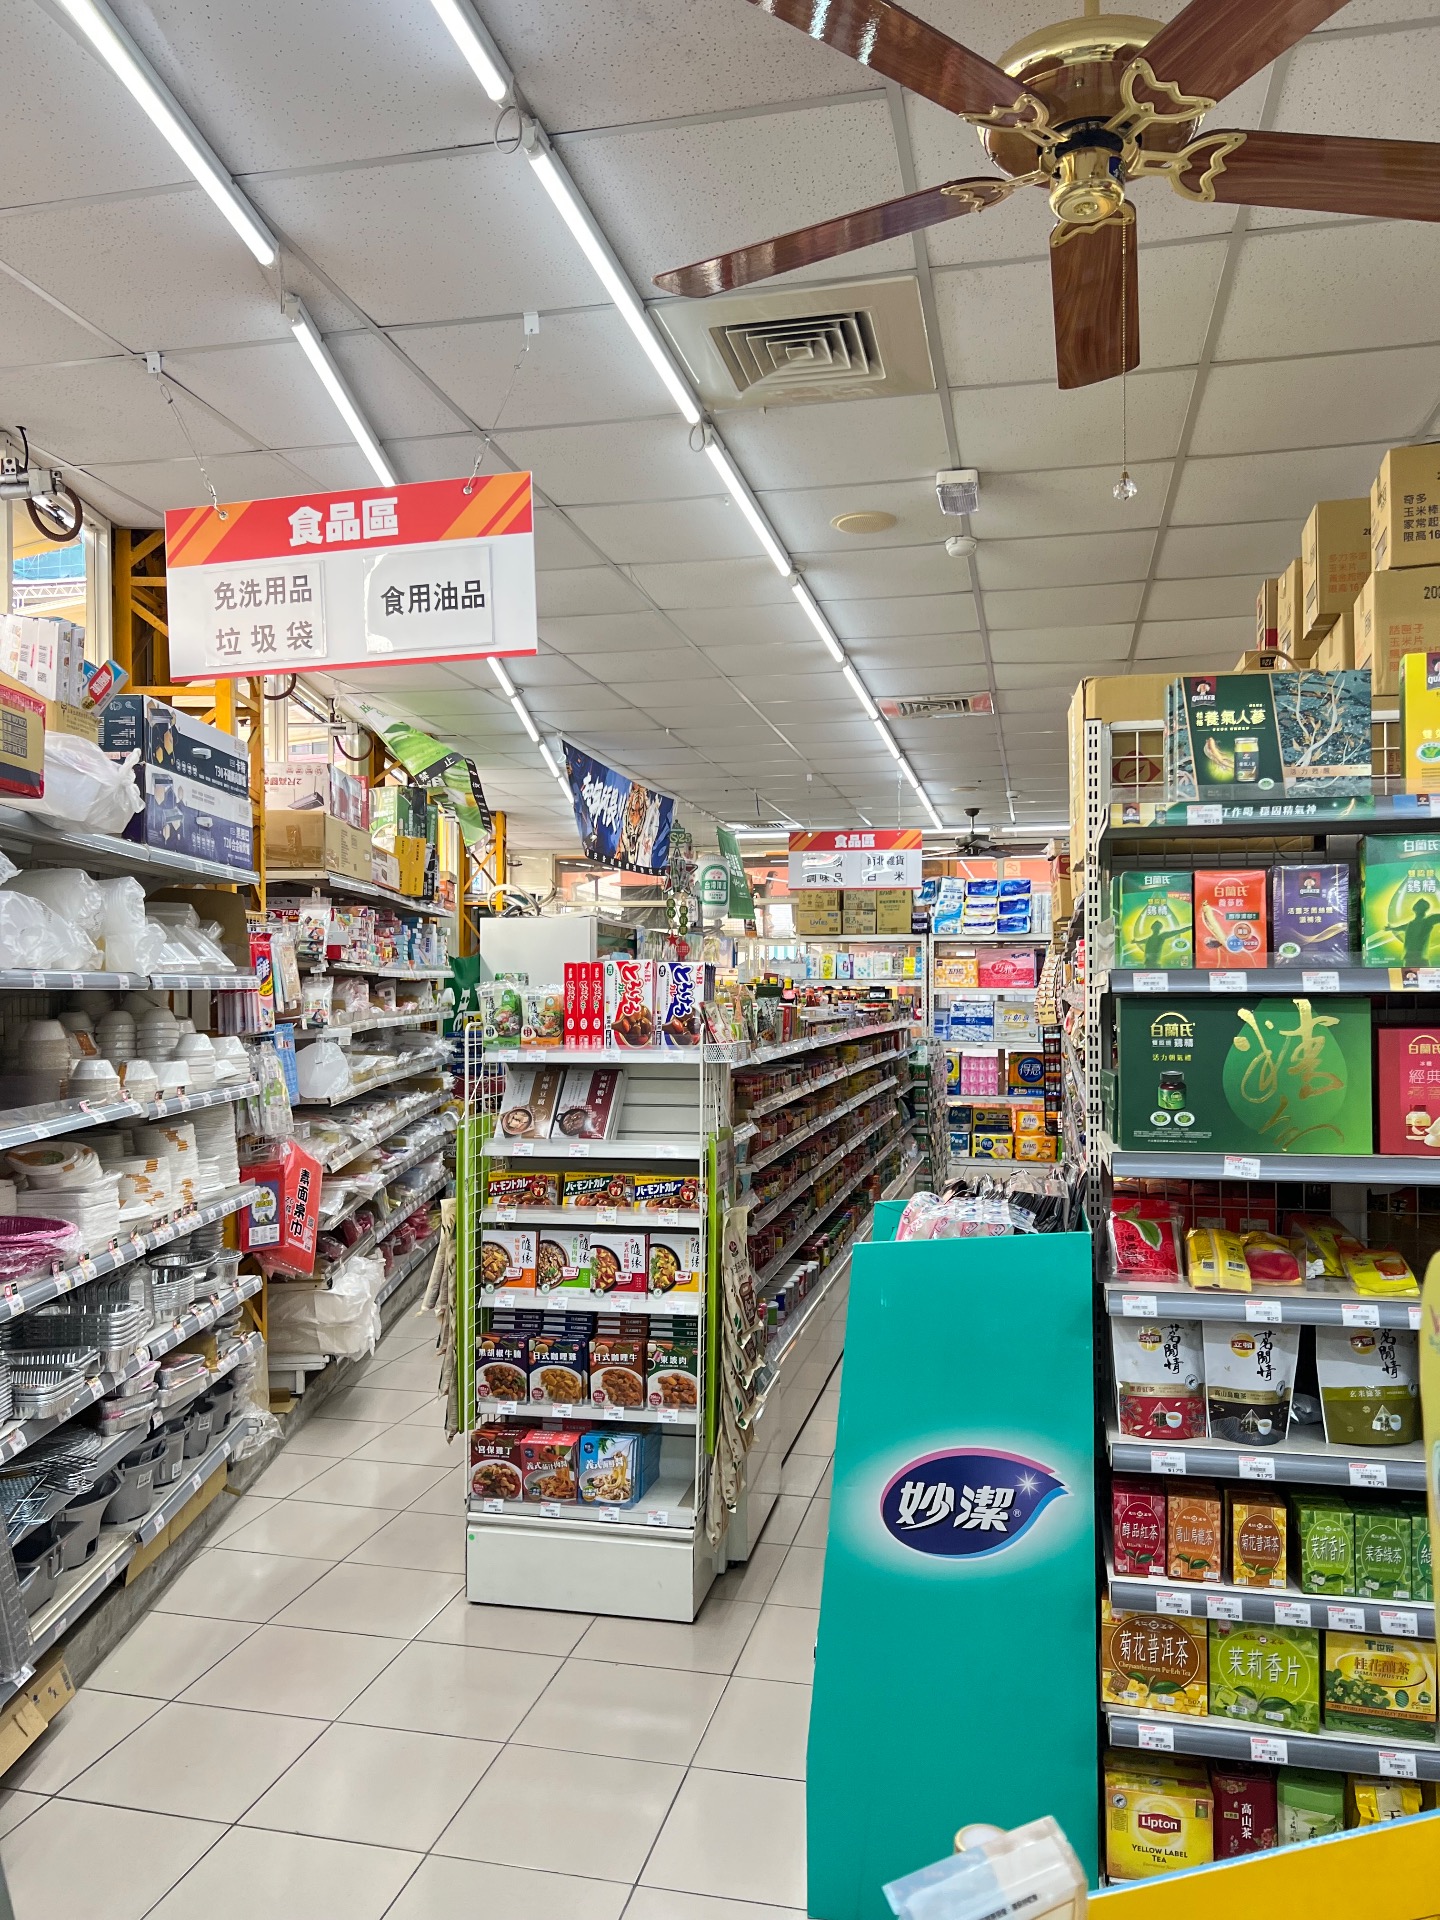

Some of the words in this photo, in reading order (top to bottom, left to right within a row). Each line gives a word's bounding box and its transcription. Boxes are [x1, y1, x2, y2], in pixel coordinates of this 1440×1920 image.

[1403, 494, 1427, 504] 奇多
[288, 496, 399, 547] 食品區
[214, 574, 313, 611] 免洗用品
[380, 580, 486, 617] 食用油品
[215, 620, 314, 656] 垃圾袋
[1389, 636, 1424, 647] 玉米片
[1191, 694, 1216, 702] QUAKER
[1203, 709, 1266, 727] 養氣人蔘
[1259, 804, 1317, 817] 穩固精氣神
[834, 833, 876, 848] 食品區
[1403, 840, 1439, 852] 白蘭氏
[1144, 875, 1171, 885] 白蘭氏
[1214, 886, 1248, 898] 白蘭氏
[621, 963, 644, 1016] とろける
[673, 965, 696, 1018] とろける
[1150, 1023, 1195, 1038] 白蘭氏
[1408, 1043, 1440, 1055] 白蘭氏
[1408, 1069, 1440, 1084] 經典
[489, 1178, 533, 1192] バーモントカレー
[565, 1178, 610, 1192] バーモントカレー
[635, 1182, 682, 1196] バーモントカレー
[1232, 1341, 1254, 1351] 立頓
[896, 1481, 1017, 1532] 妙潔
[1121, 1521, 1159, 1541] 醇品紅茶
[1175, 1525, 1213, 1546] 高山烏龍茶
[1240, 1533, 1280, 1554] 菊花普洱茶
[1310, 1535, 1347, 1561] 茉莉香片
[1365, 1545, 1402, 1565] 茉香綠茶
[1119, 1629, 1189, 1668] 菊花普洱茶
[1118, 1660, 1161, 1674] Chrysanthemum
[1181, 1668, 1191, 1677] Tea
[1226, 1645, 1301, 1688] 茉莉香片
[1353, 1656, 1410, 1676] 桂花釀茶
[1354, 1669, 1395, 1680] OSMANTHUS
[1396, 1674, 1408, 1682] TEA
[1141, 1816, 1178, 1832] Lipton
[1240, 1802, 1253, 1840] 高山茶
[1132, 1843, 1163, 1856] YELLOW
[1164, 1848, 1188, 1860] LABEL
[1152, 1854, 1167, 1864] TEA
